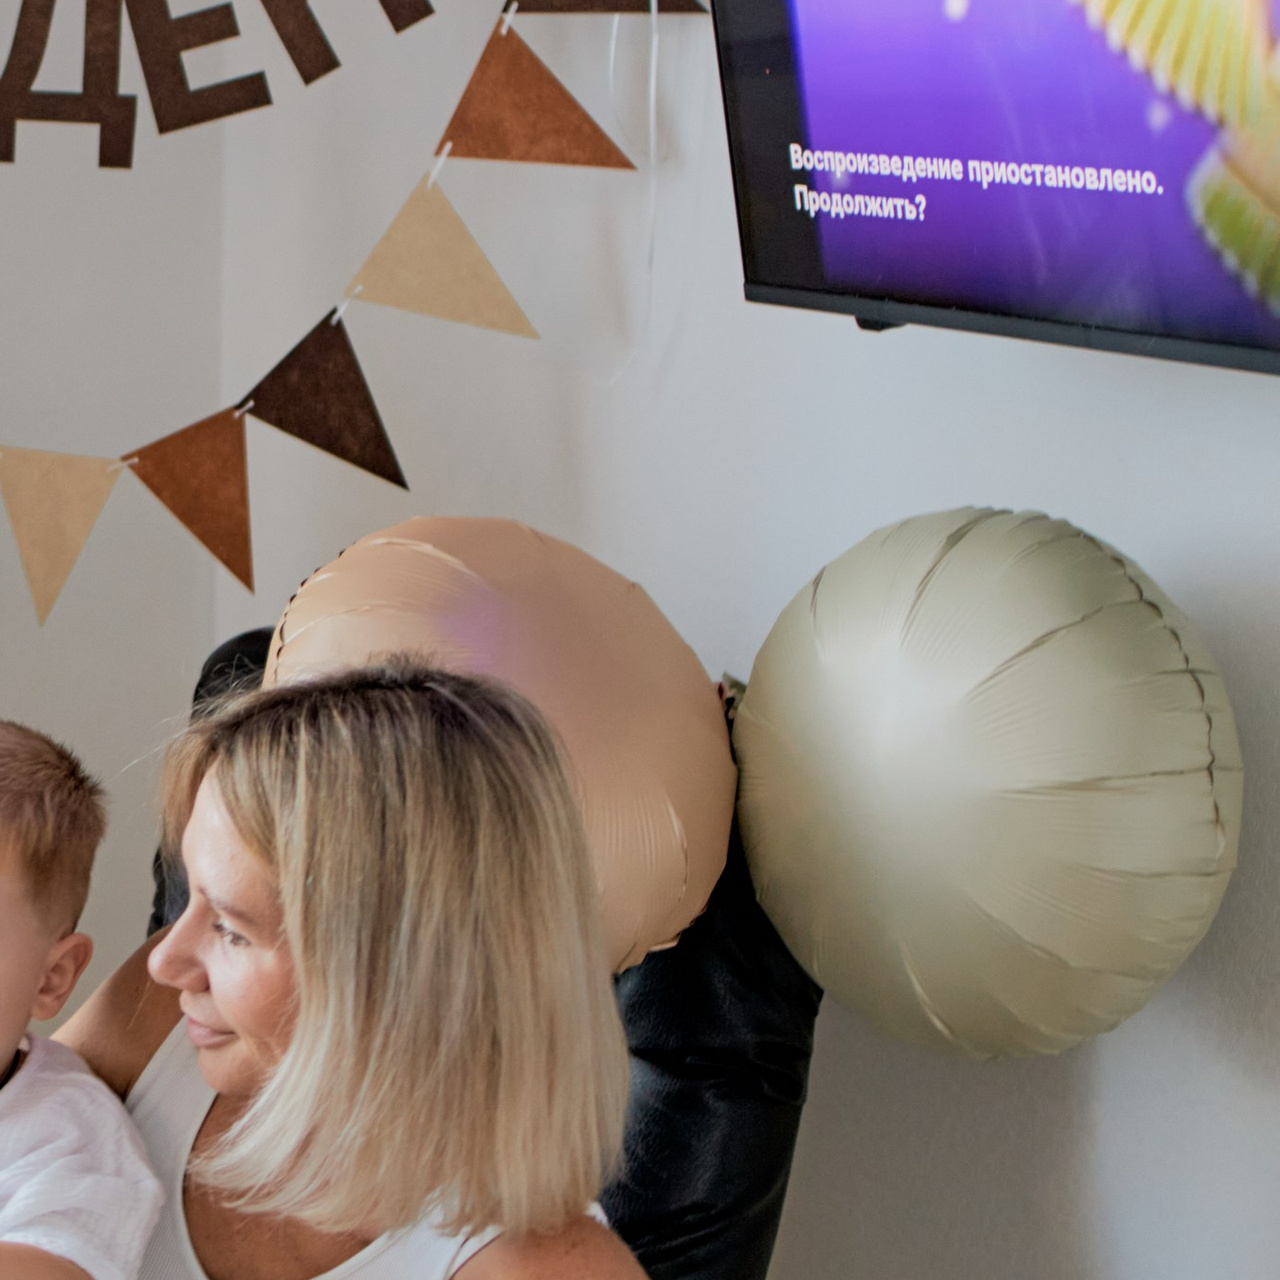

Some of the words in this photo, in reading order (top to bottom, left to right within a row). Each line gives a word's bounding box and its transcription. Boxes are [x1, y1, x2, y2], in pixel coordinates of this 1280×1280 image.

[789, 142, 964, 183] Воспроизведение
[967, 159, 1164, 195] приостановлено.
[794, 183, 927, 221] Продолжить?
